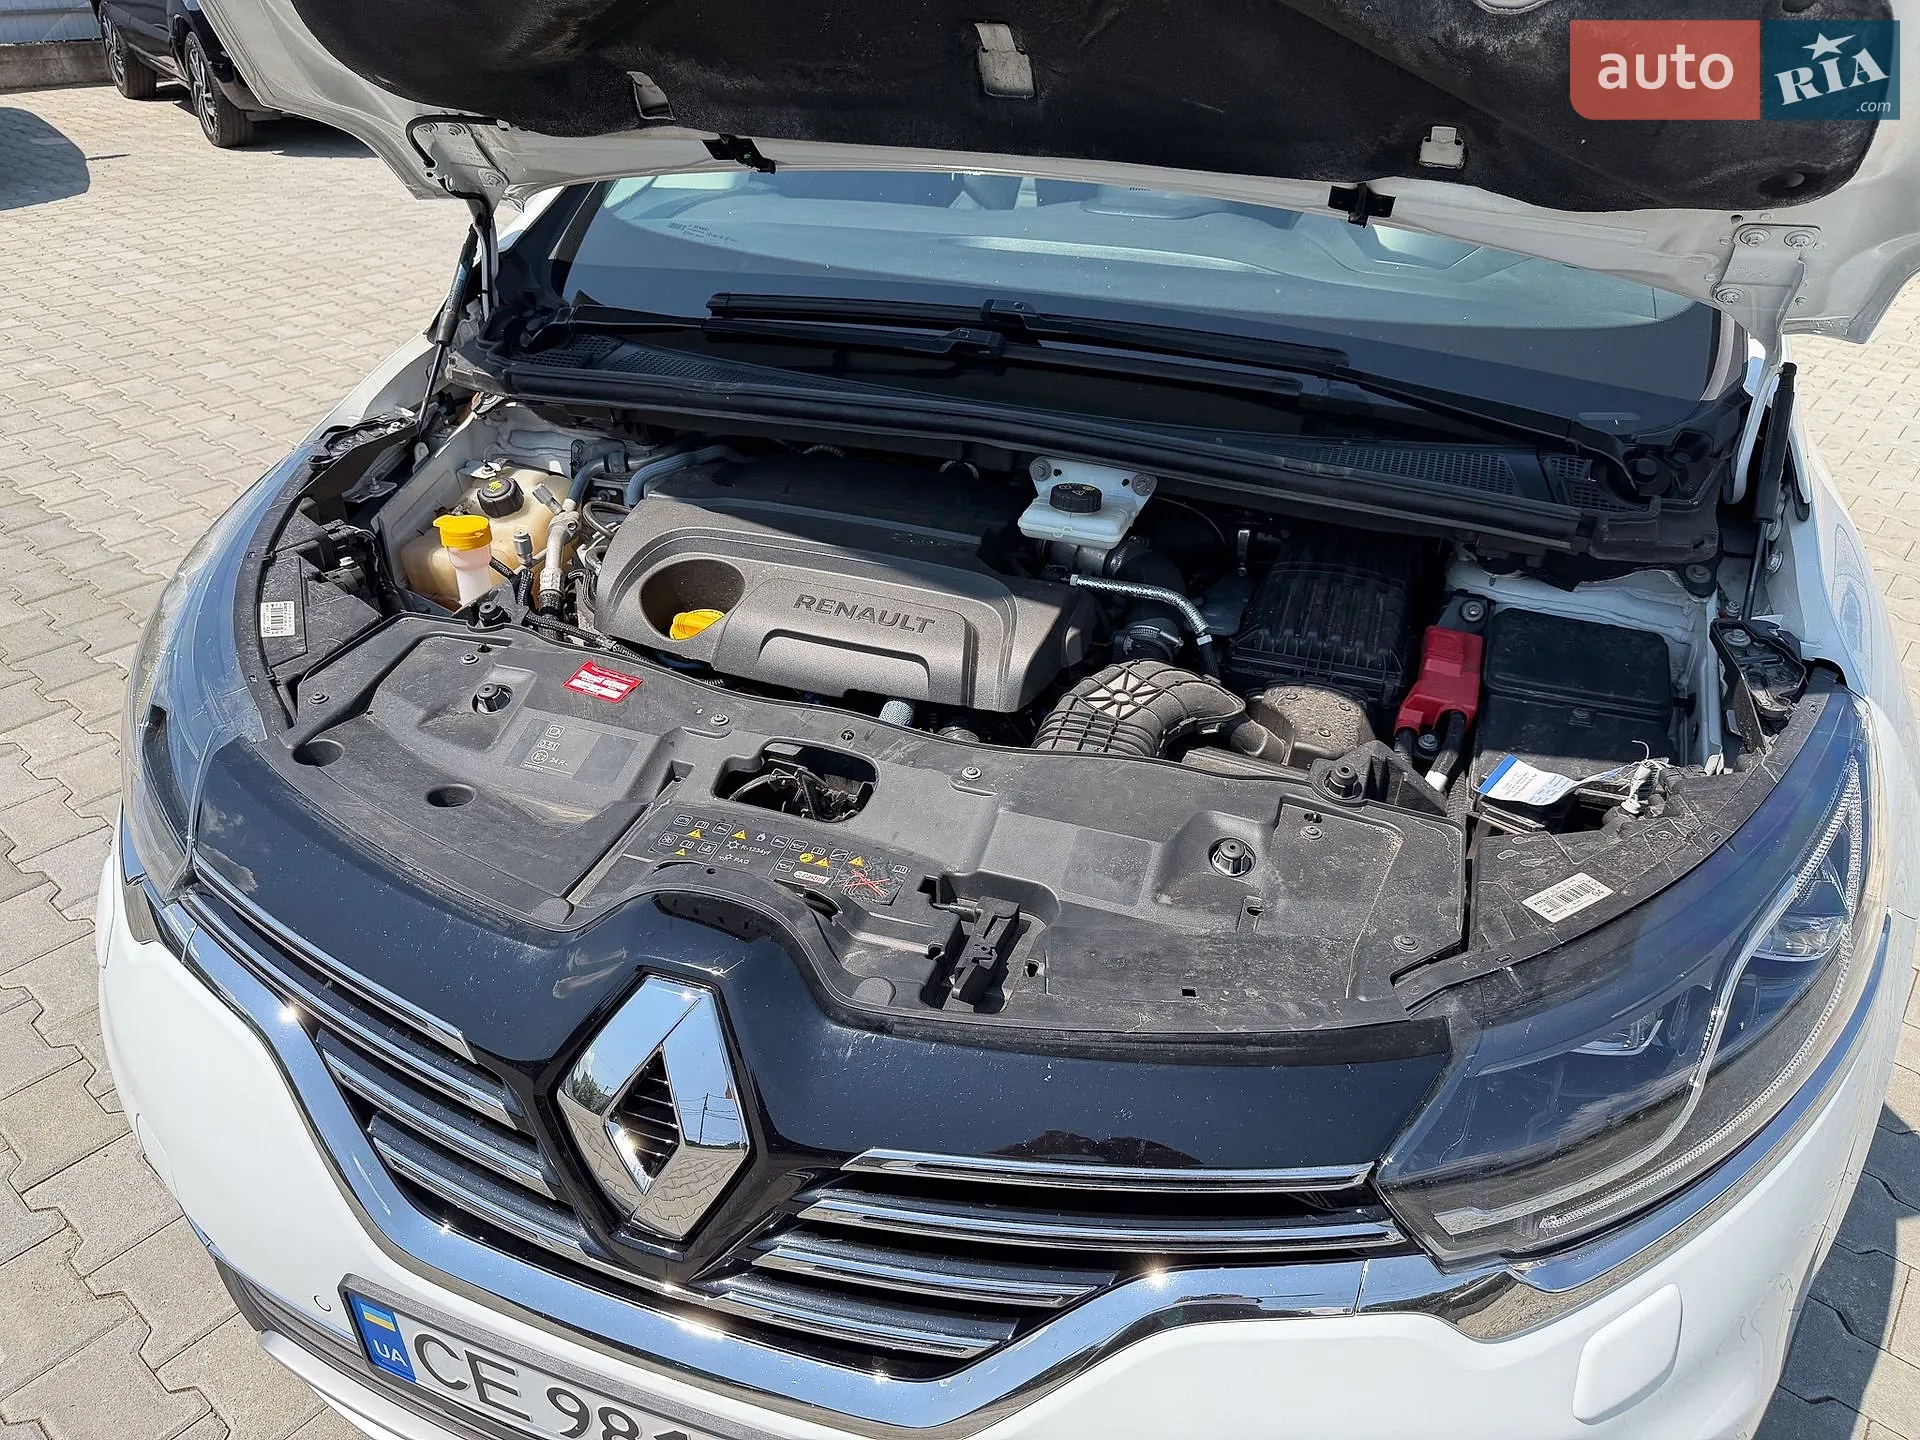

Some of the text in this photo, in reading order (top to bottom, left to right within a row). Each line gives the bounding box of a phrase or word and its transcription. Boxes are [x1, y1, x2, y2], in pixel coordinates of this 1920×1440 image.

[793, 593, 935, 634] RENAULT
[373, 1339, 407, 1368] UA
[414, 1333, 688, 1440] CE 98
